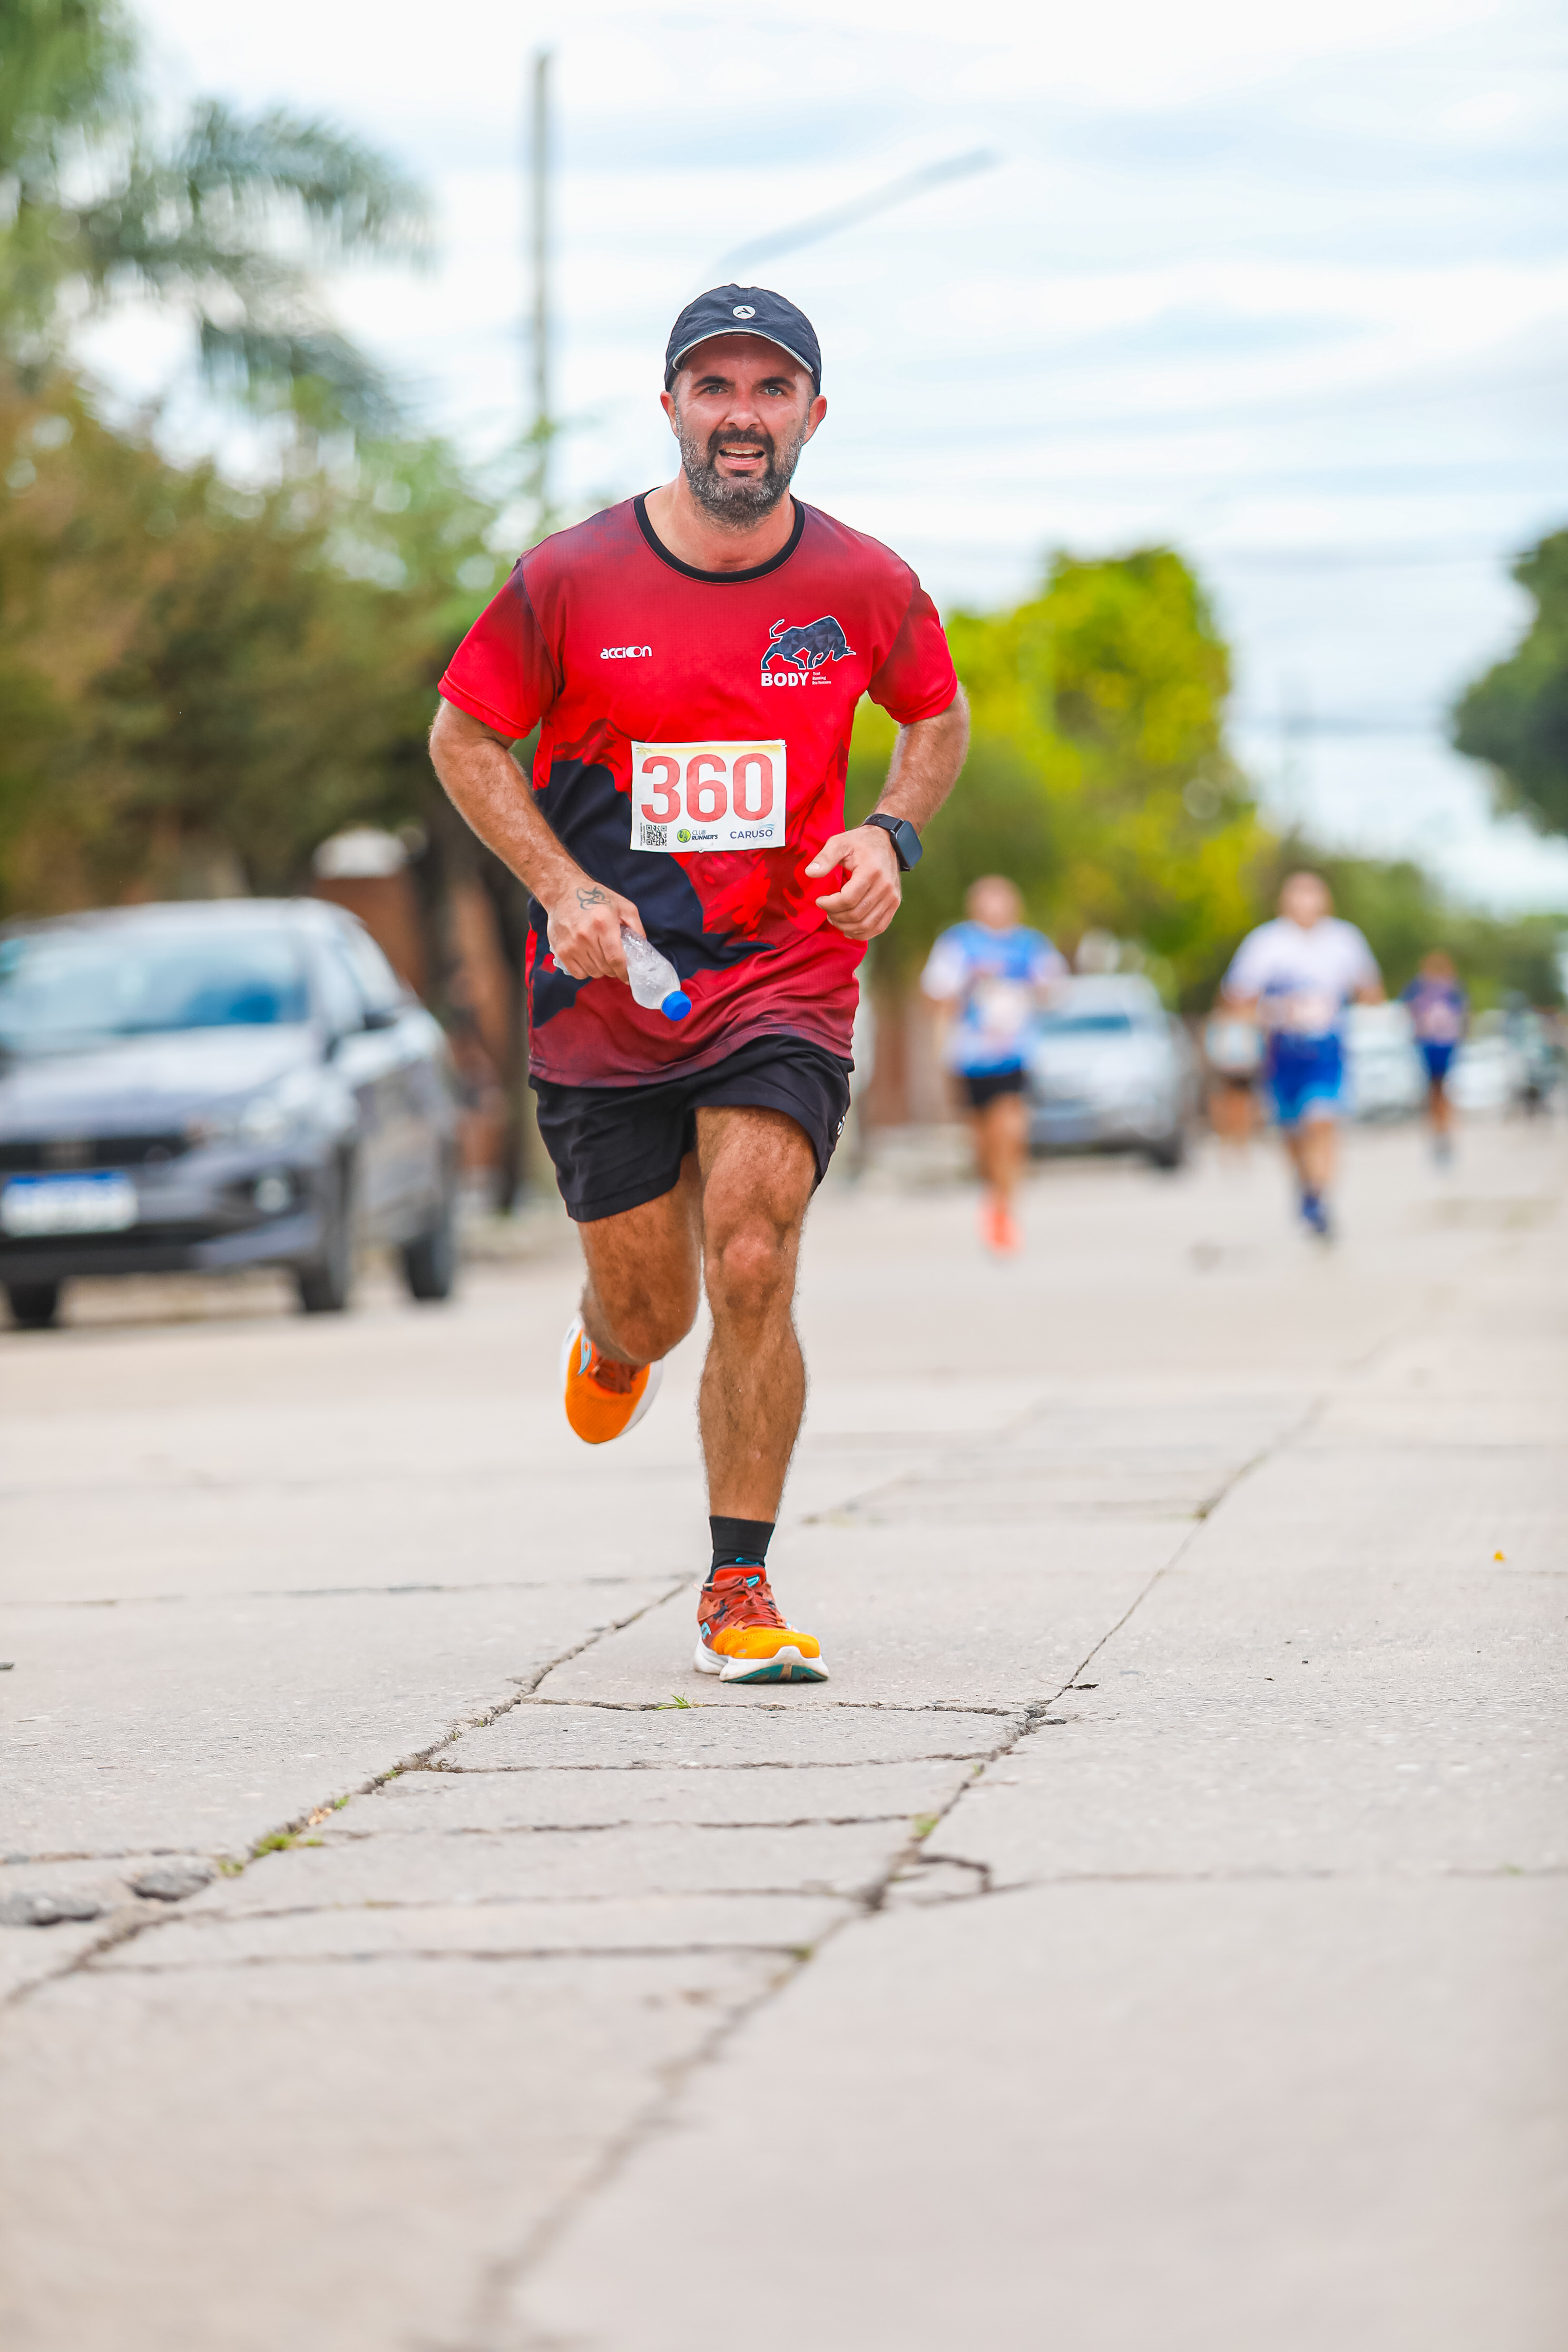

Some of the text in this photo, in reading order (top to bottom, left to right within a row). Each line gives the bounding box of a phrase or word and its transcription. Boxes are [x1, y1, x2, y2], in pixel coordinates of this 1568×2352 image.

[761, 672, 809, 687] BODY
[641, 753, 773, 824] 360
[730, 829, 773, 839] CARUSO
